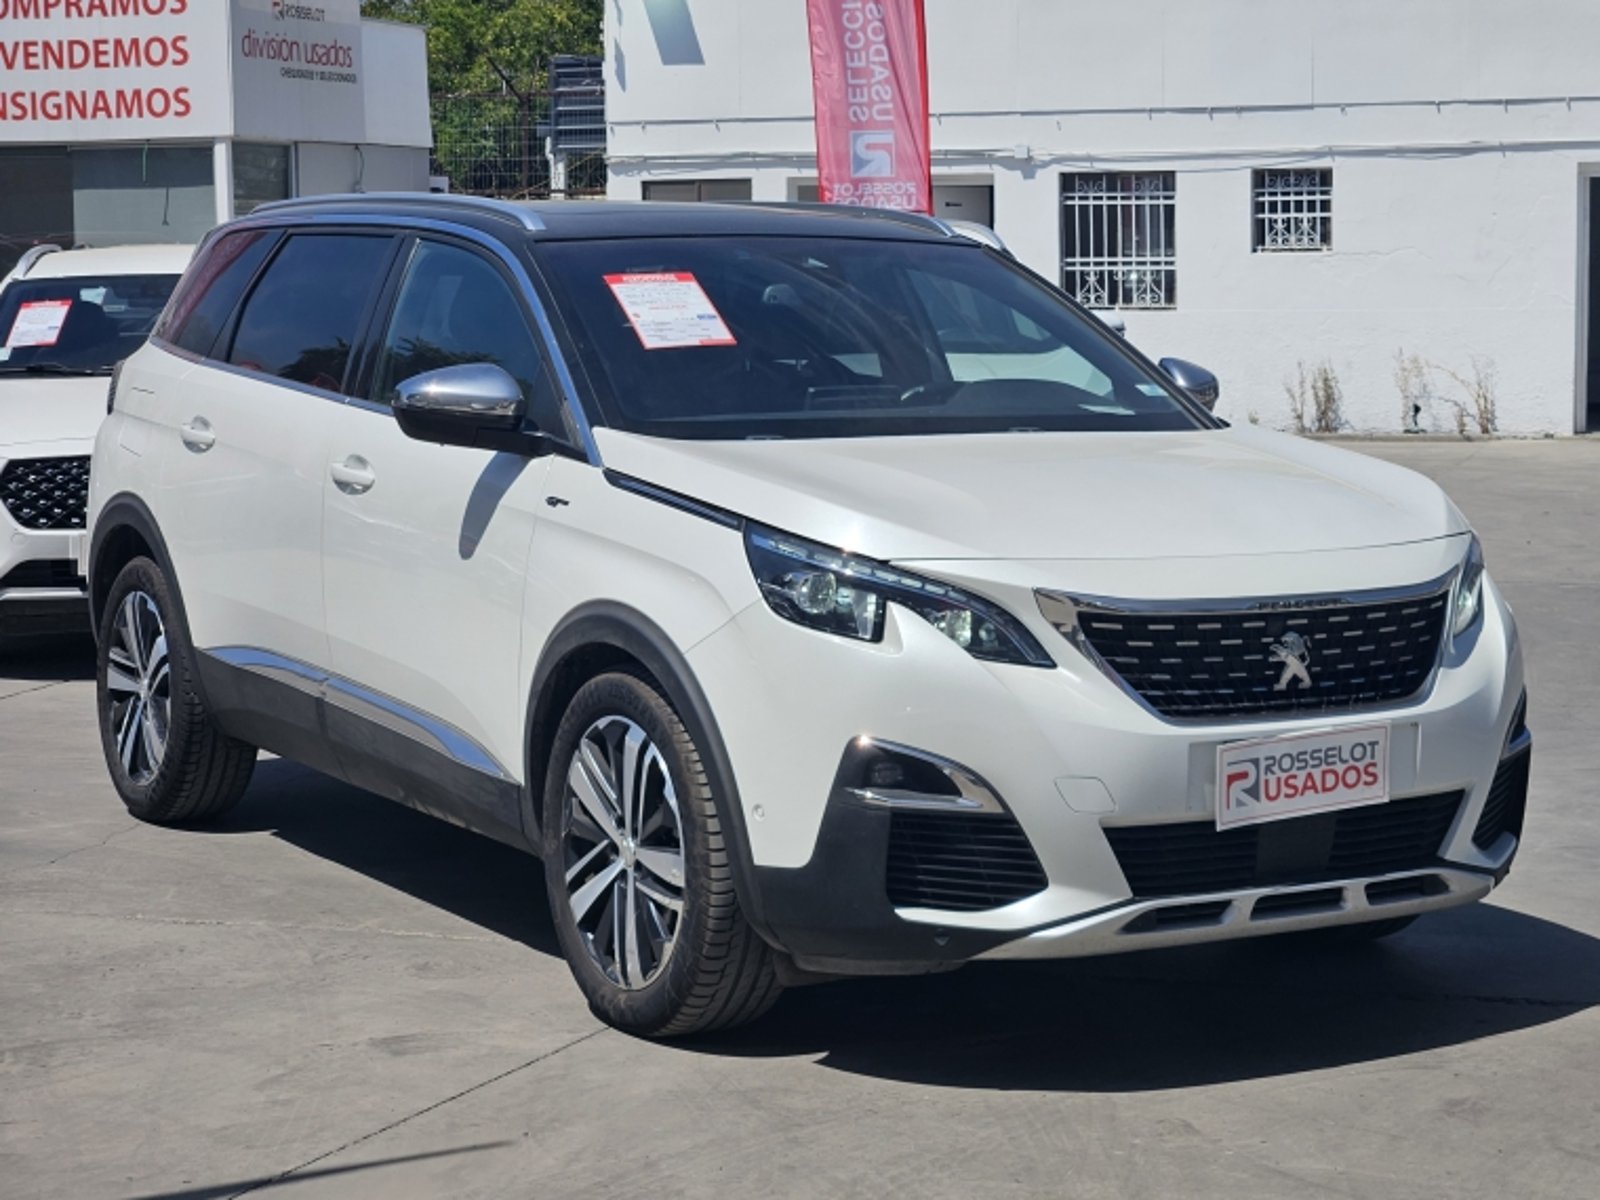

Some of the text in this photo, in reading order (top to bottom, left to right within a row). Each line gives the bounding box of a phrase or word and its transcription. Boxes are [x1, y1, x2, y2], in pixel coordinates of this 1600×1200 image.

[0, 35, 189, 70] VENDEMOS
[241, 28, 352, 68] división usados
[1264, 741, 1379, 776] ROSSELOT
[1264, 763, 1379, 801] USADOS
